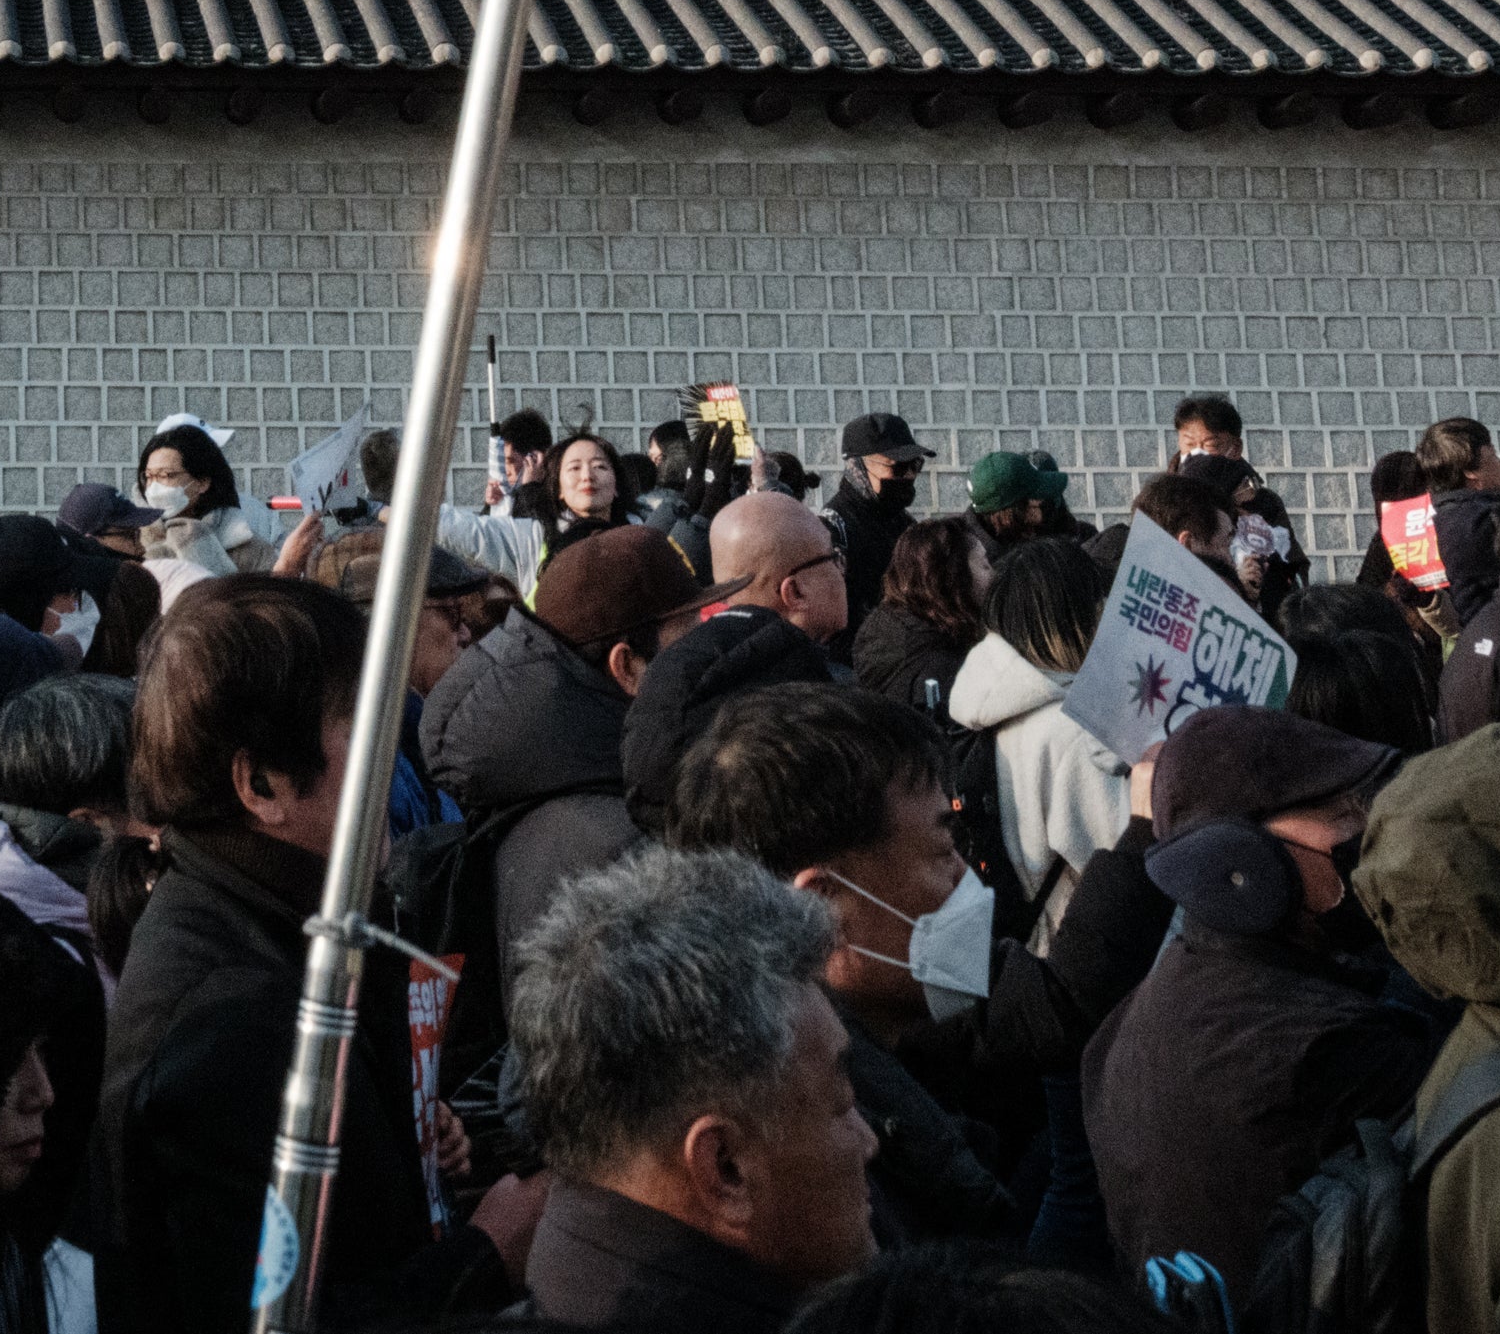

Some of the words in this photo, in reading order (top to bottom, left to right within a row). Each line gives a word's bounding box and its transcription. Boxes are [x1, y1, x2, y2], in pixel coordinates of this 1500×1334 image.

[1118, 593, 1194, 654] 국민의힘
[1126, 563, 1201, 624] 내란동조
[1192, 603, 1284, 709] 해체
